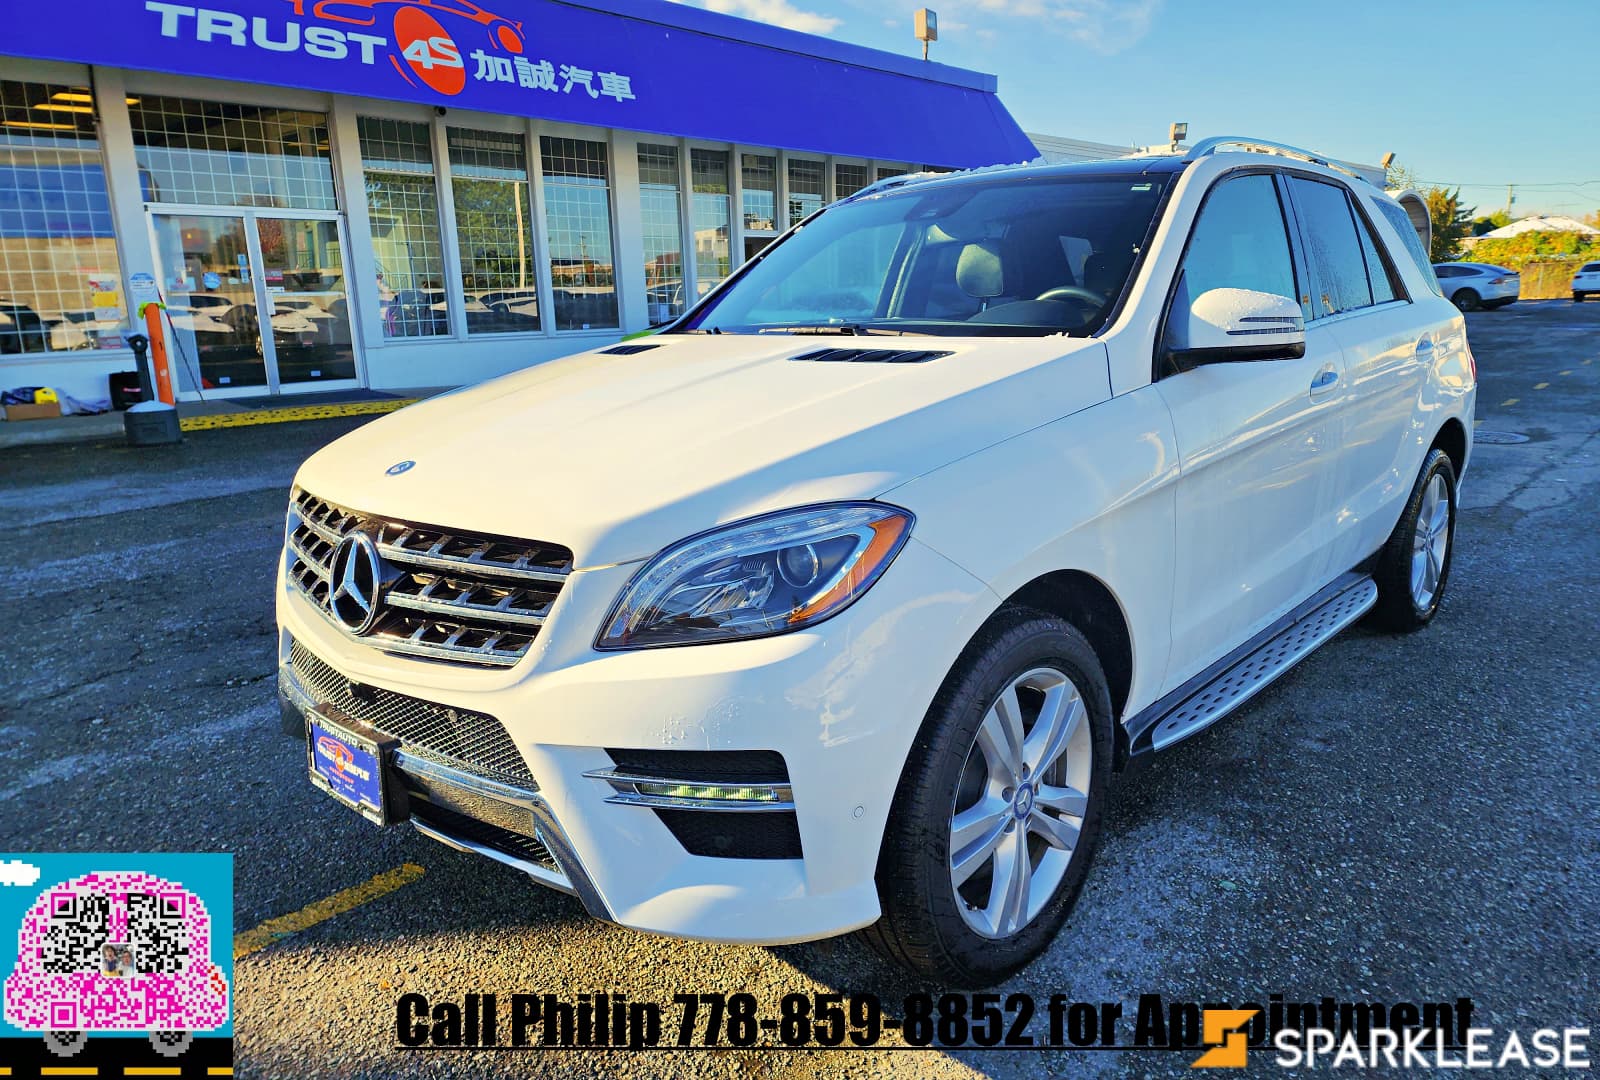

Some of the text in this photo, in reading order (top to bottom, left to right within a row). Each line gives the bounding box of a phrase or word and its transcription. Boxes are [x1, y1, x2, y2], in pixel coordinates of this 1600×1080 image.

[145, 1, 464, 70] TRUST 4S
[470, 49, 636, 102] 加誠汽車
